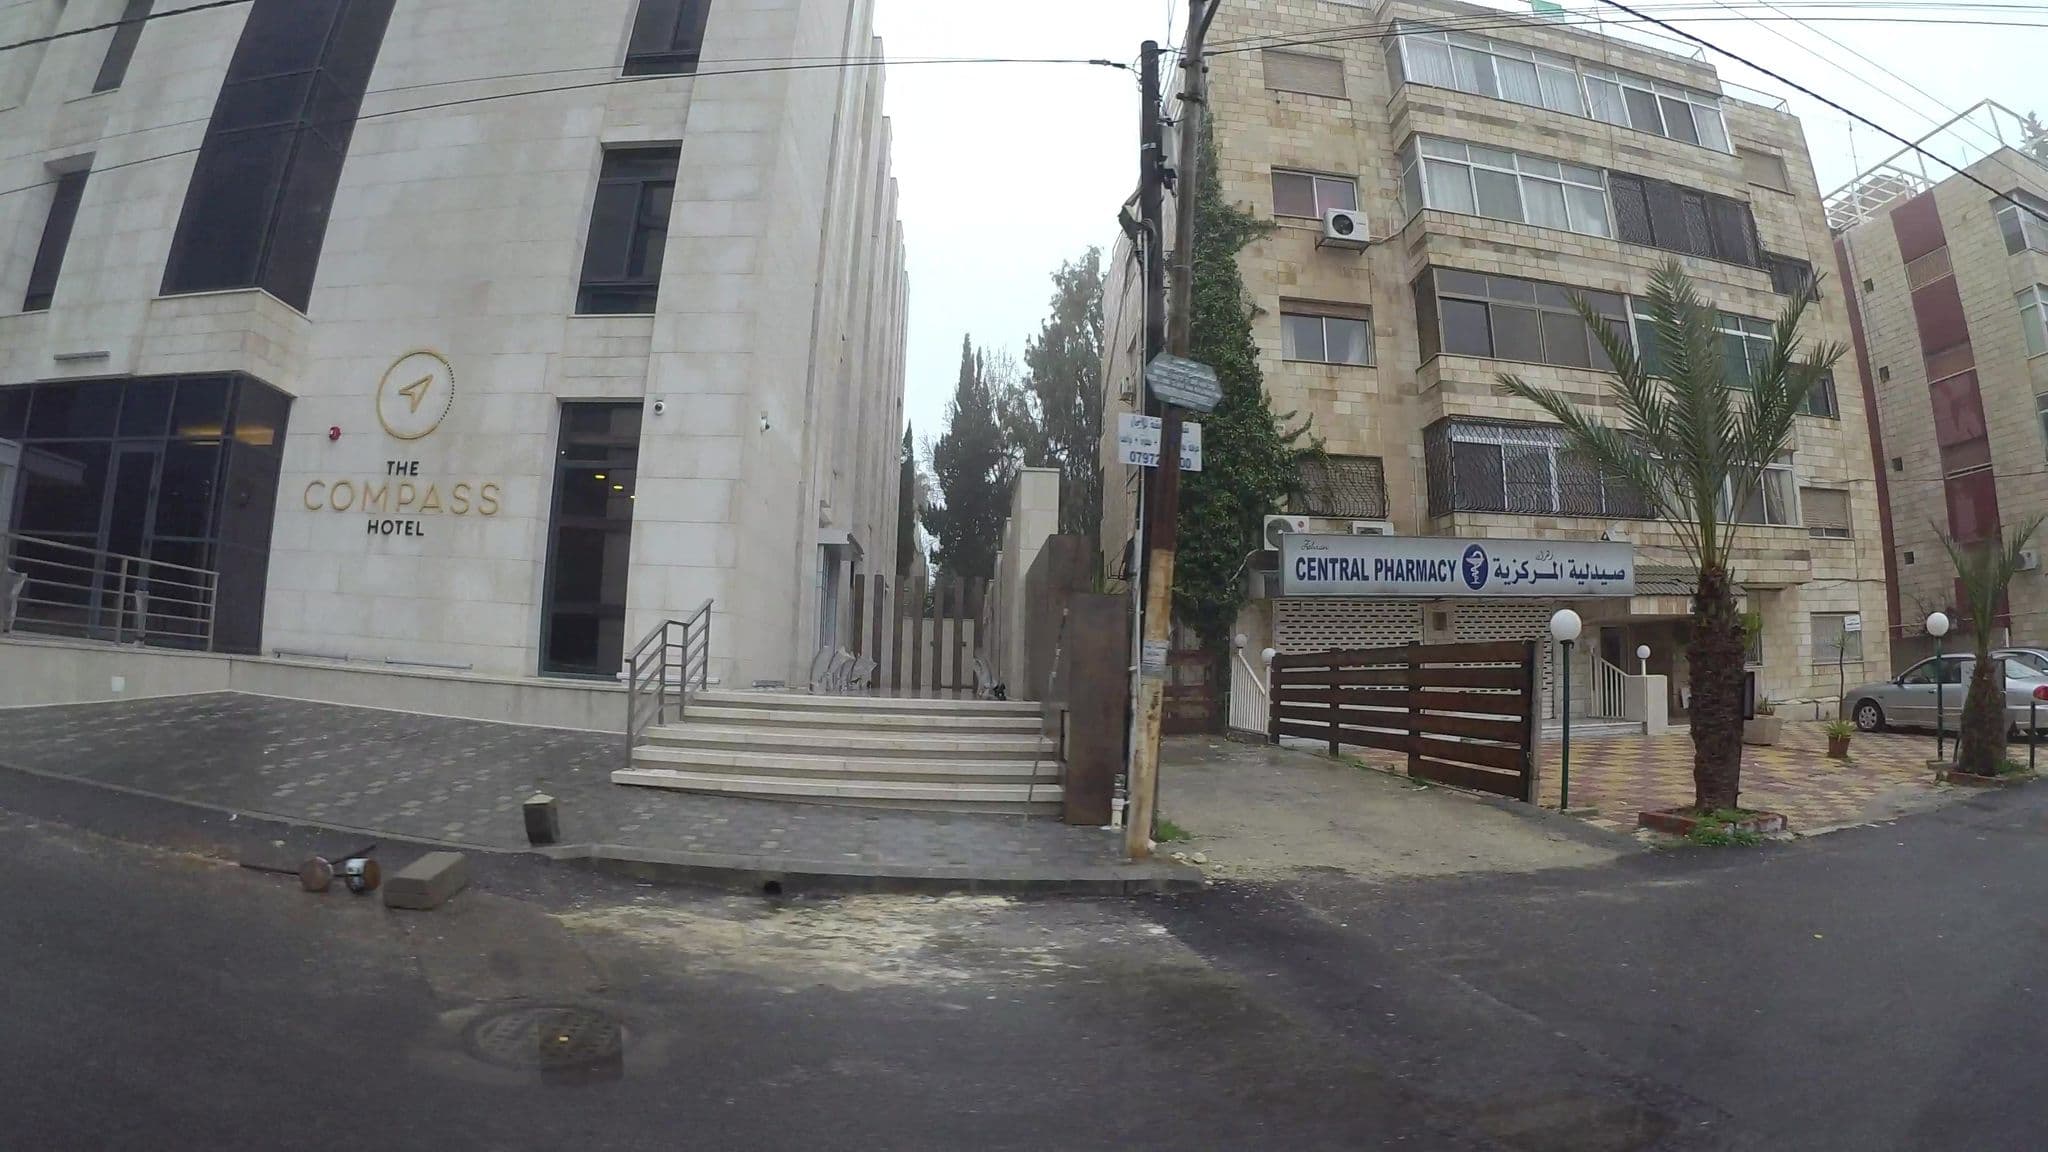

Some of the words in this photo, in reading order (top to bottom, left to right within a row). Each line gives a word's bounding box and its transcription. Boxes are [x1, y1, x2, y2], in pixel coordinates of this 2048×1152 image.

[386, 460, 420, 477] THE
[303, 479, 502, 516] COMPASS
[367, 519, 425, 536] HOTEL
[1295, 556, 1370, 581] CENTRAL
[1374, 558, 1457, 582] PHARMACY
[1492, 557, 1564, 586] المركزية
[1567, 558, 1626, 585] صيدلية
